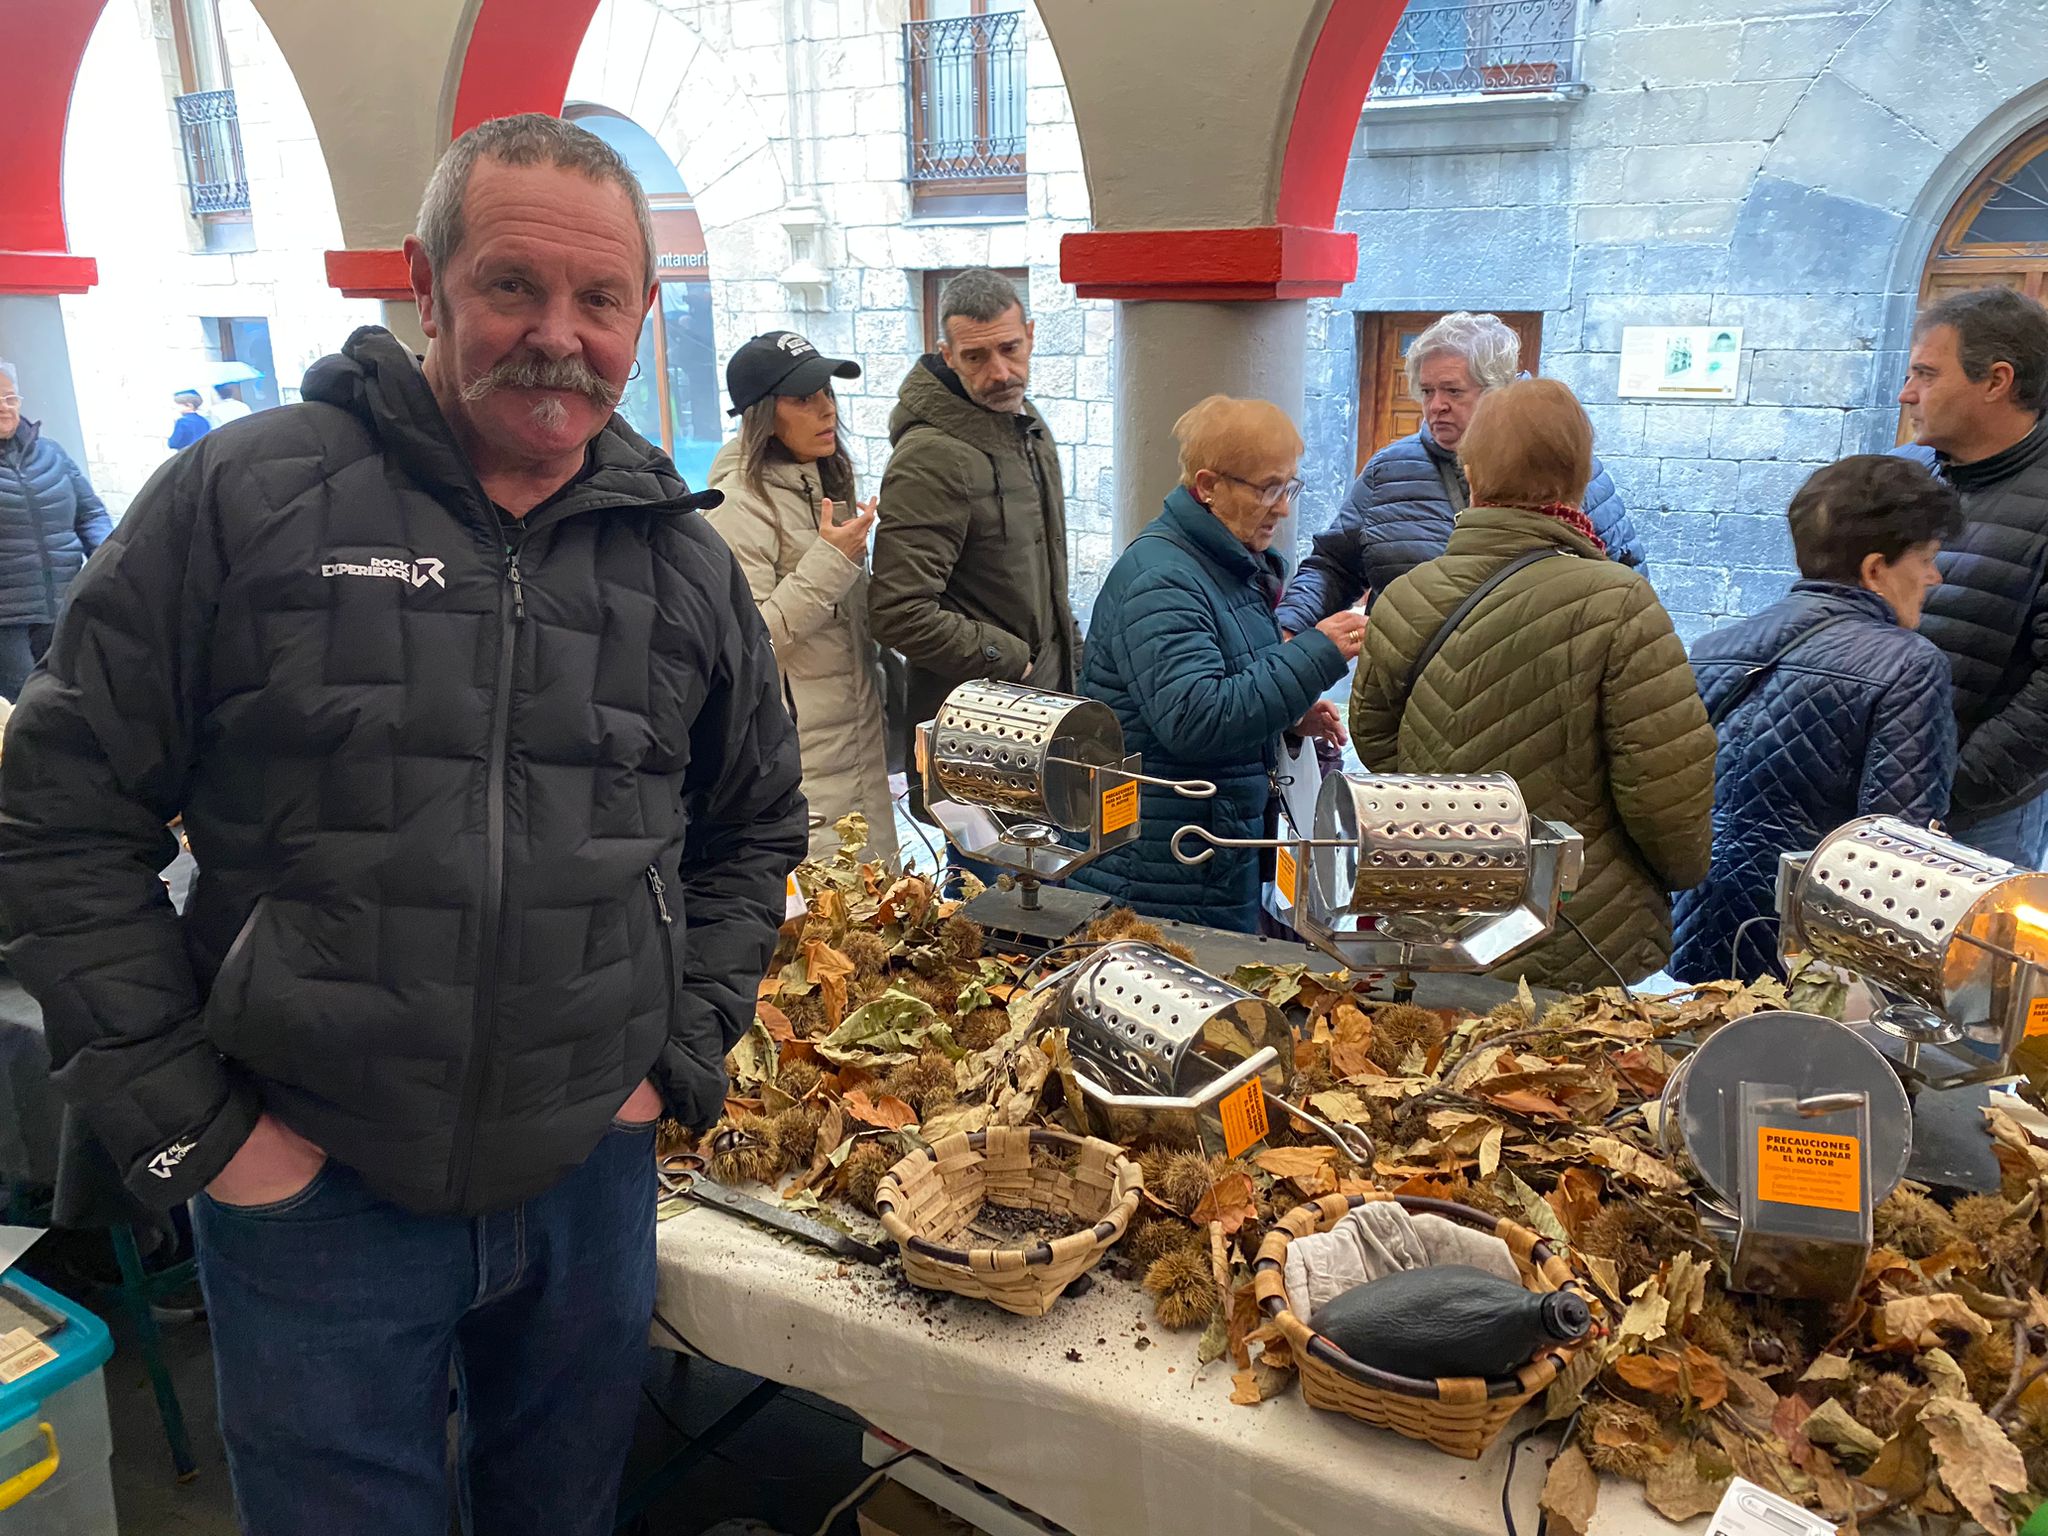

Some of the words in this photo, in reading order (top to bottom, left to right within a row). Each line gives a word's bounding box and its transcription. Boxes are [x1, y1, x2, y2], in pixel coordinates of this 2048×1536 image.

[370, 557, 410, 572] ROCK
[321, 563, 410, 583] EXPERIENCE
[1766, 1135, 1851, 1151] PRECAUCIONES
[1766, 1145, 1793, 1154] PARA
[1796, 1148, 1812, 1156] NO
[1782, 1155, 1794, 1163] EL
[1796, 1156, 1834, 1167] MOTOR
